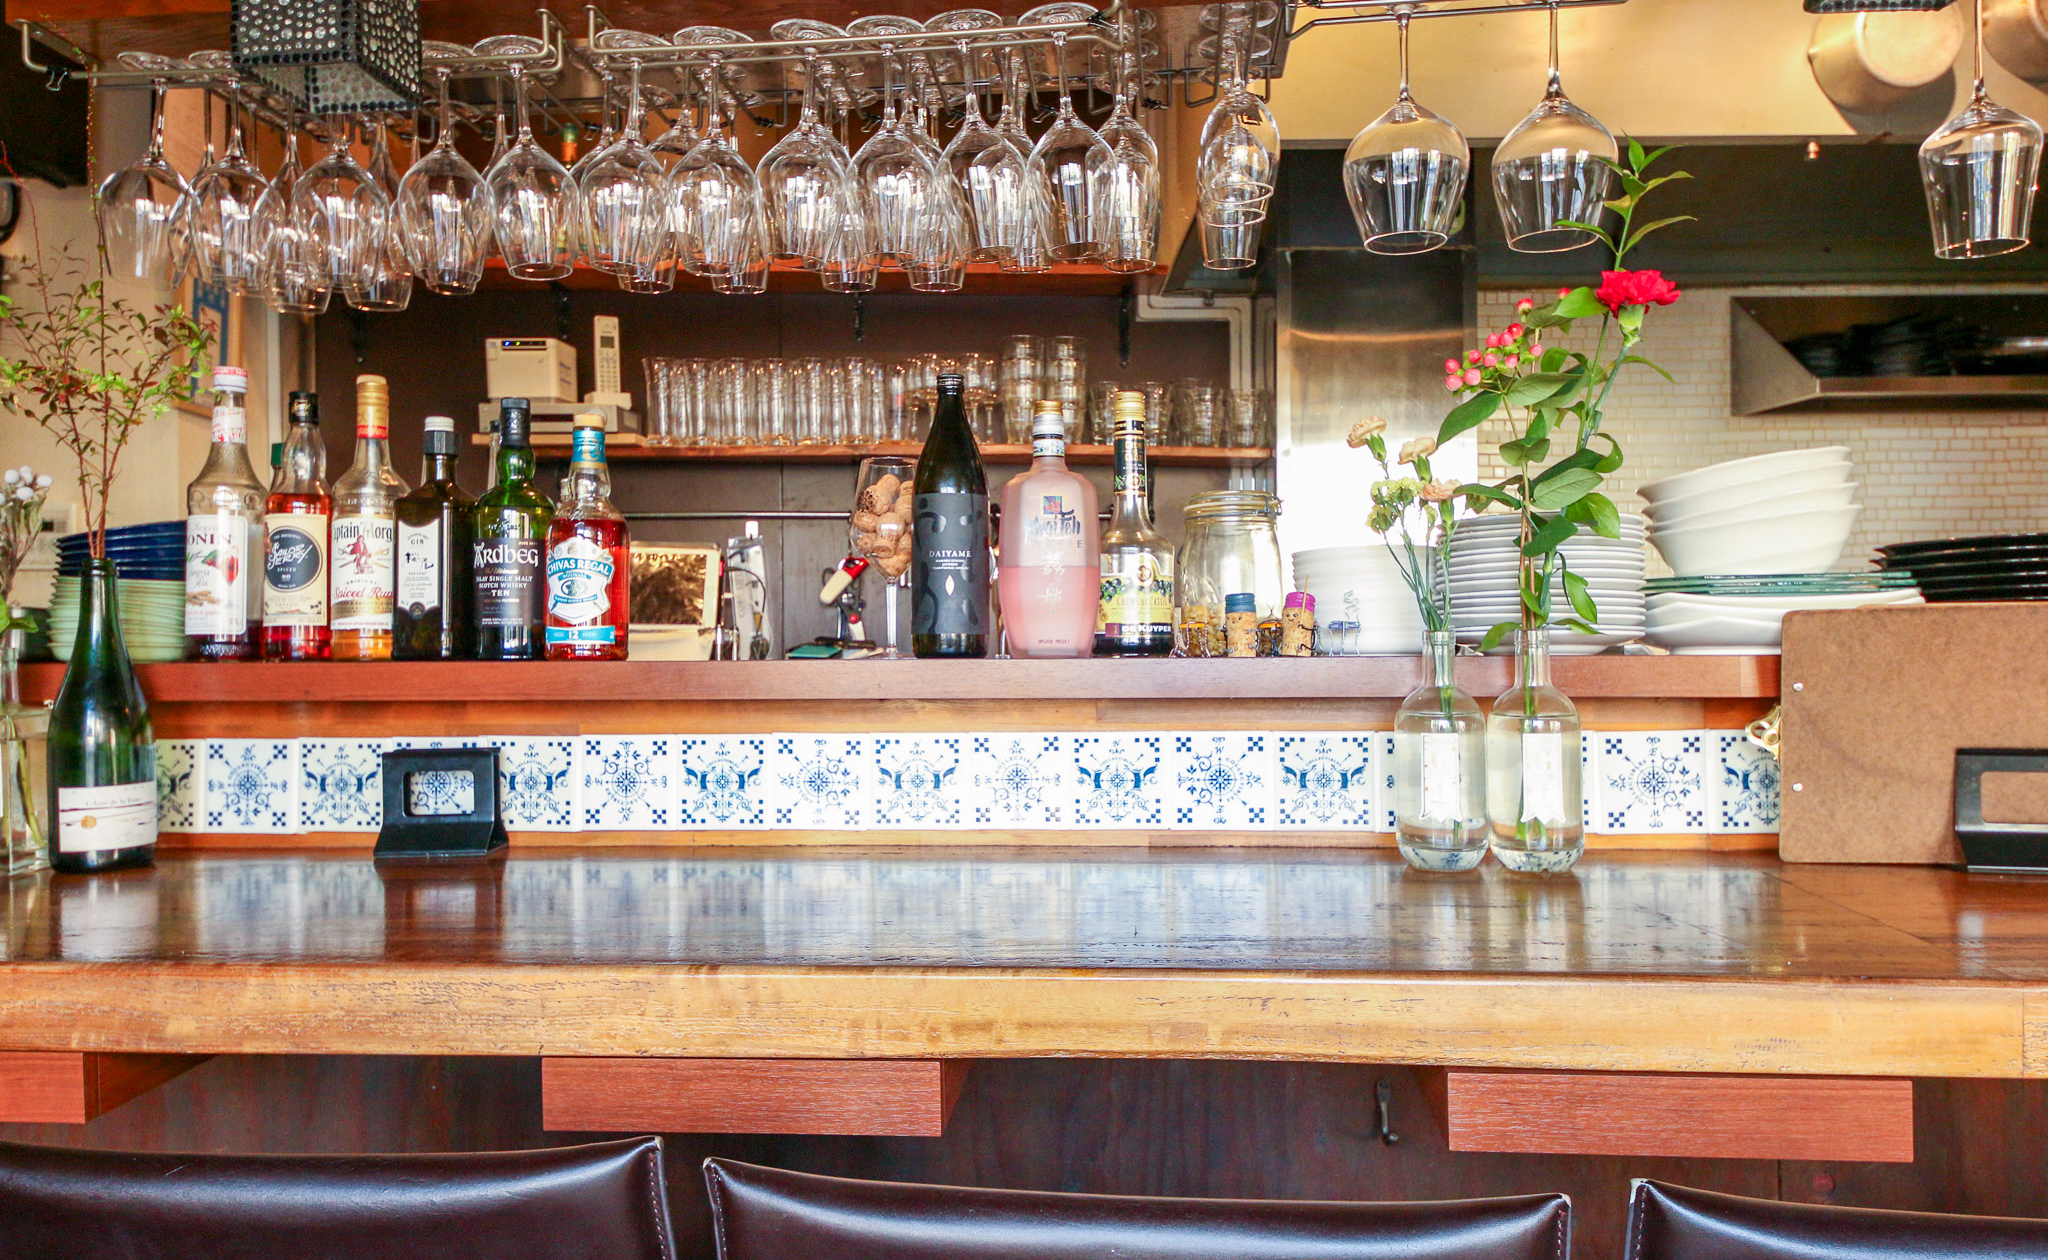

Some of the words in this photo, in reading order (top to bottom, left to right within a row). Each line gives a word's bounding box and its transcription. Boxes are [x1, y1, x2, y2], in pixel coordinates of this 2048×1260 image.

[333, 522, 360, 543] aptain
[361, 522, 393, 543] Morg
[187, 533, 232, 545] ONIN
[473, 542, 539, 569] Ardbeg
[547, 559, 576, 575] CHIVAS
[577, 559, 610, 575] REGAL
[334, 587, 366, 599] Spiced
[1138, 624, 1172, 632] KUYPER
[568, 630, 579, 639] 12
